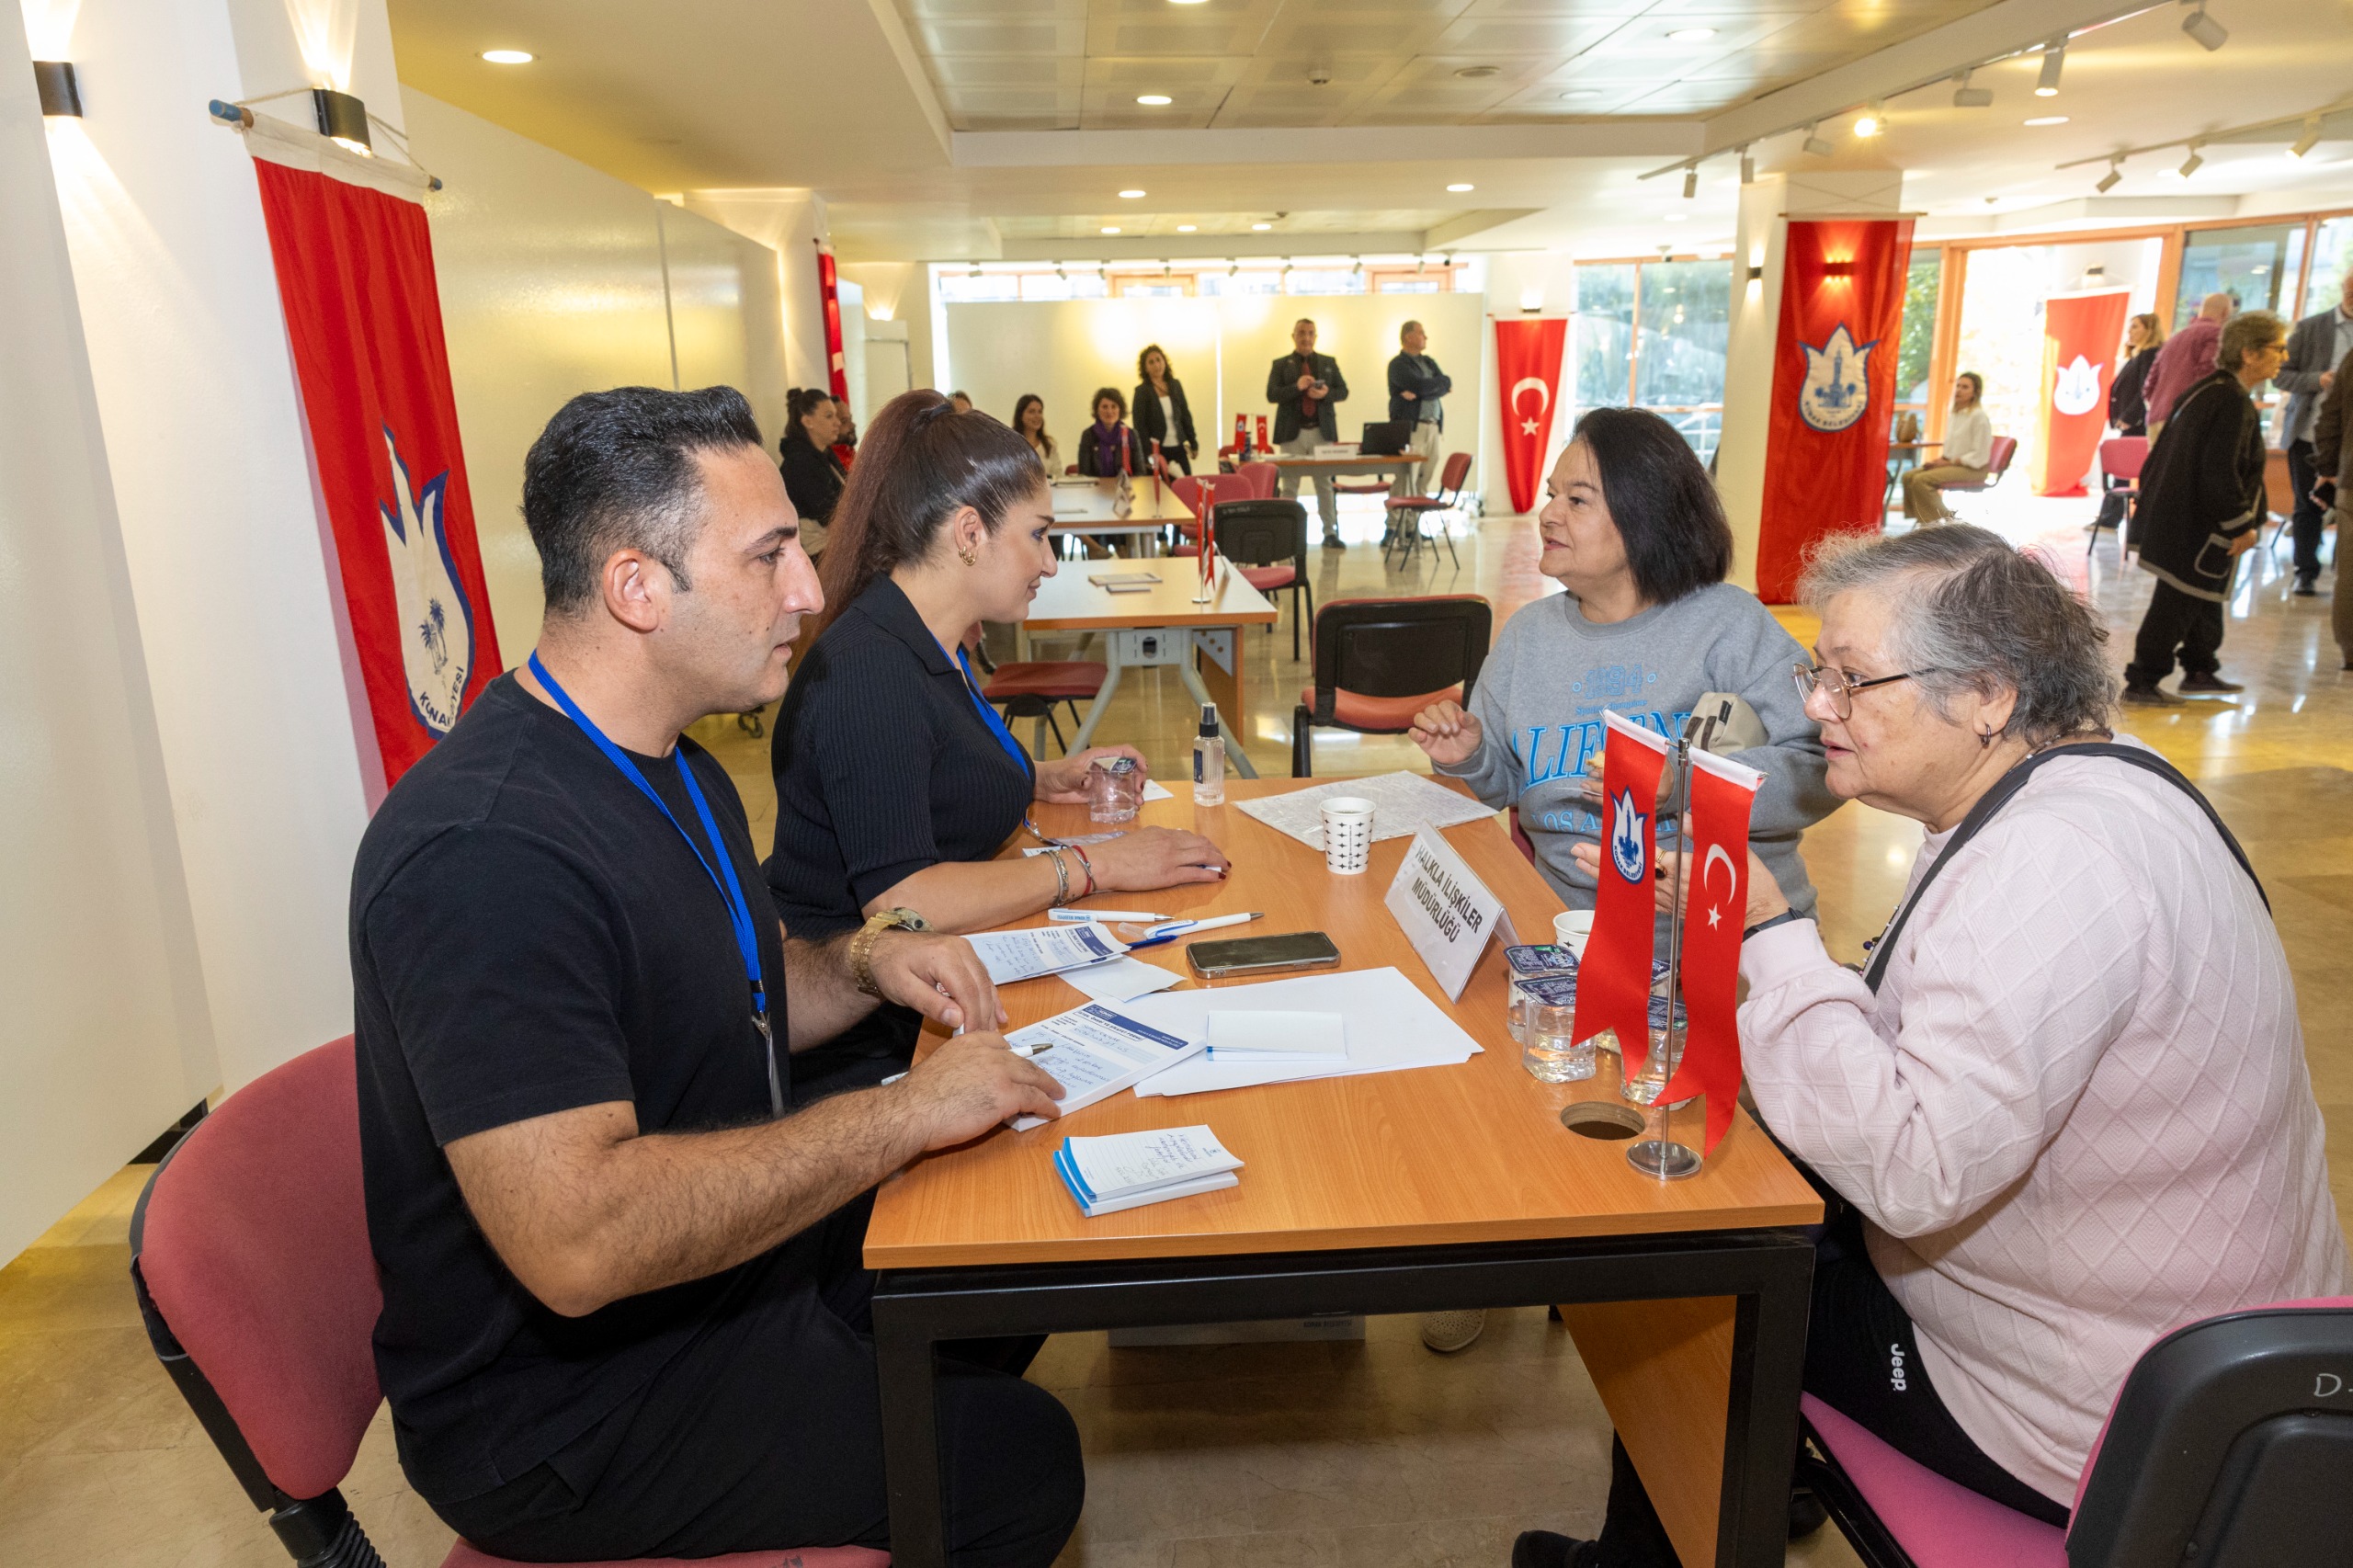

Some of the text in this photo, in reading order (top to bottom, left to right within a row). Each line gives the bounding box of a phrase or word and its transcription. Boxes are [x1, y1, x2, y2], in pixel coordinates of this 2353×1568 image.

[1411, 877, 1461, 943] MÜDÜRLÜĞÜ
[1415, 844, 1483, 934] HALKLA İLİŞKİLER
[1891, 1343, 1907, 1391] Jeep
